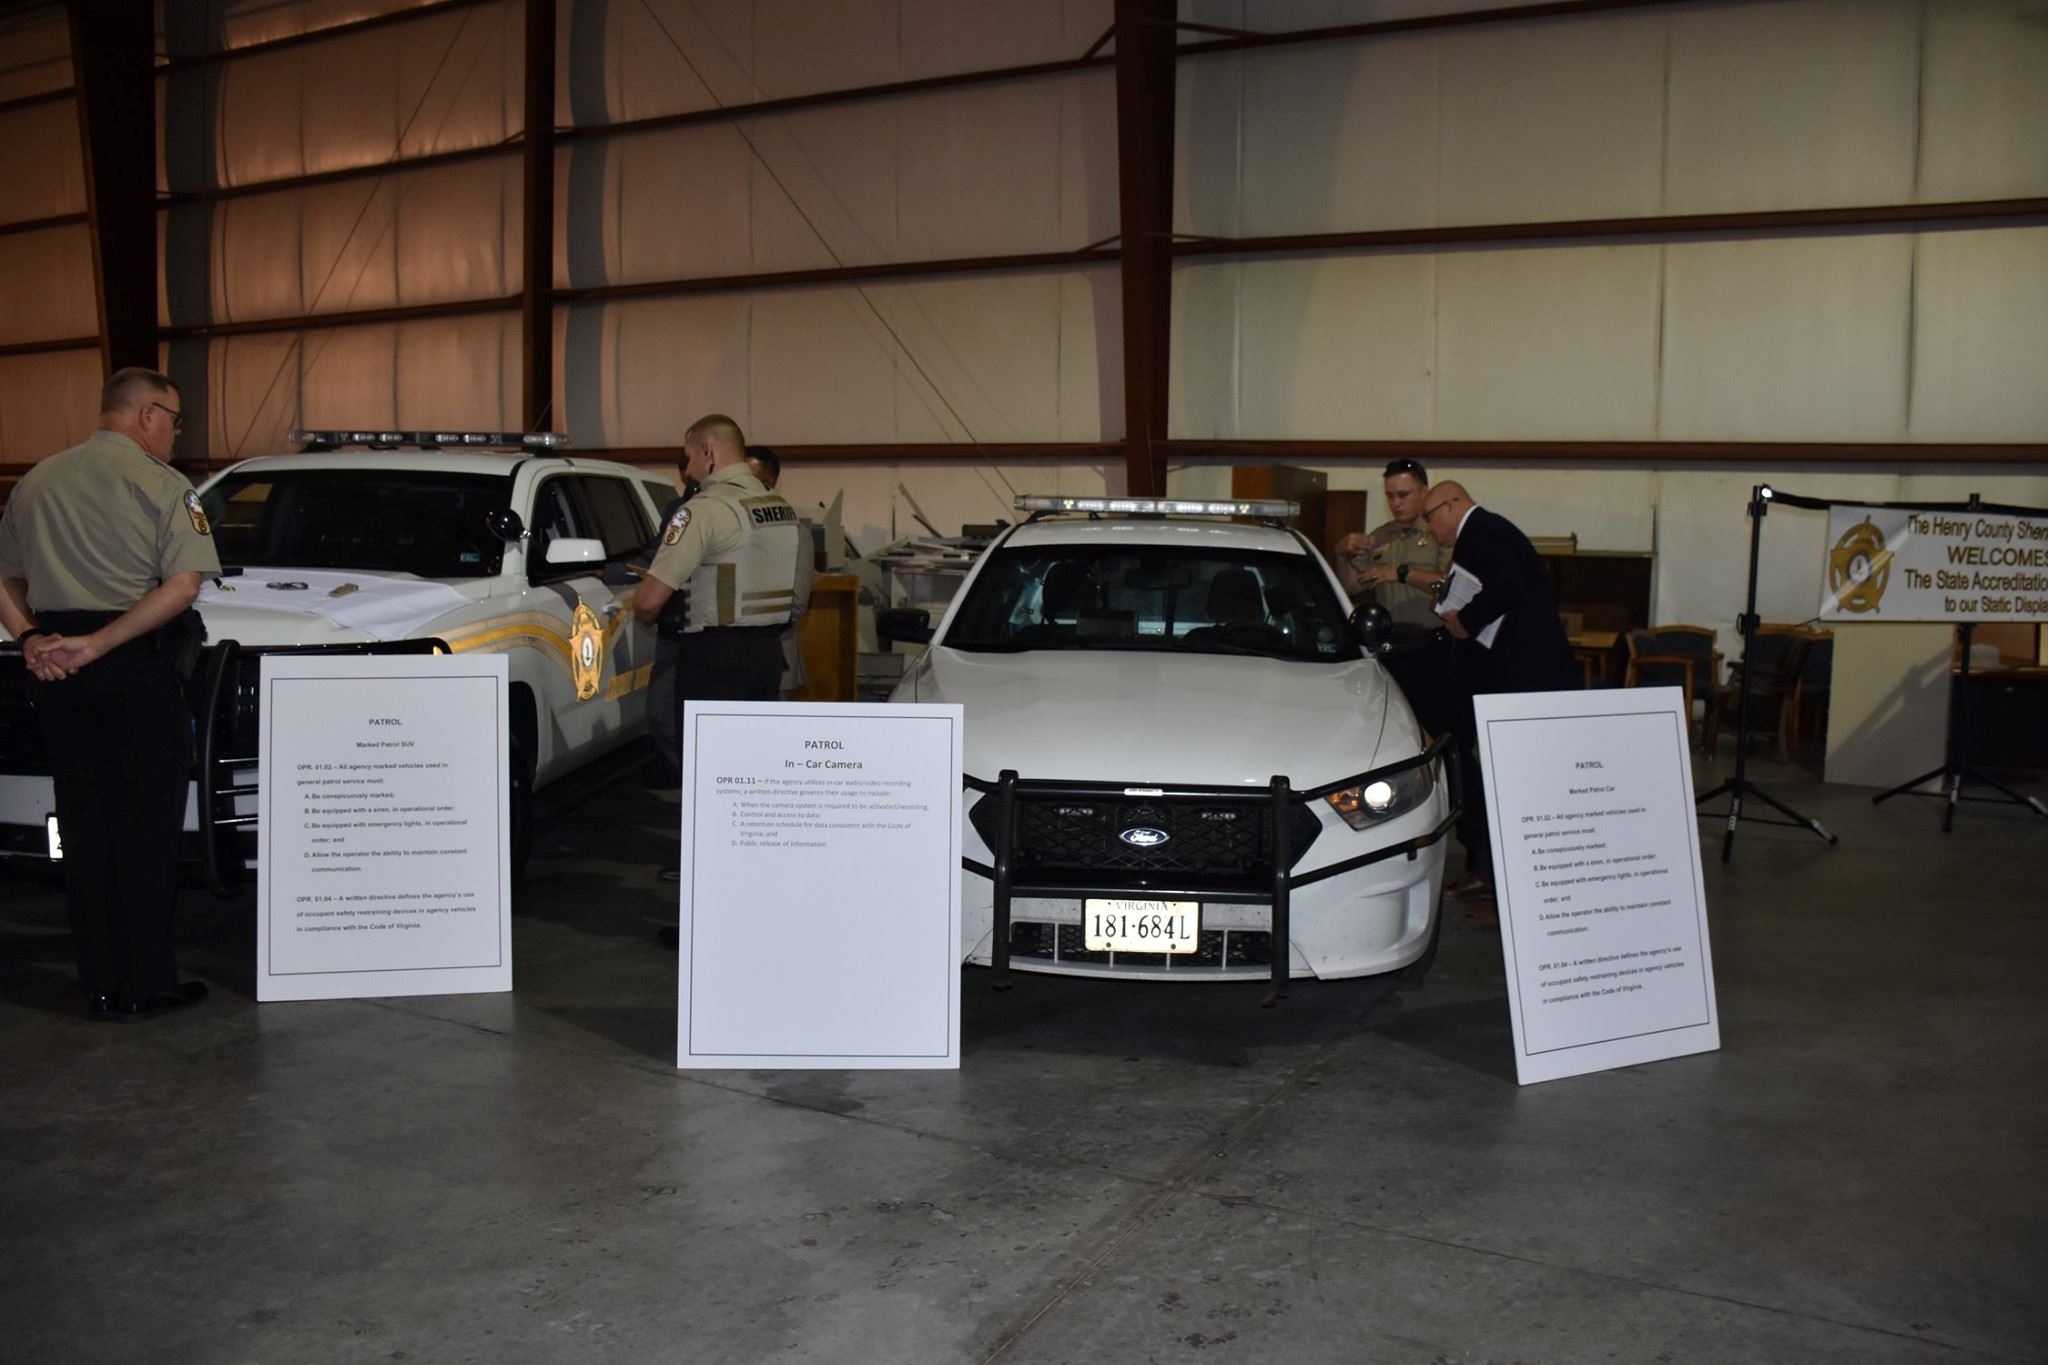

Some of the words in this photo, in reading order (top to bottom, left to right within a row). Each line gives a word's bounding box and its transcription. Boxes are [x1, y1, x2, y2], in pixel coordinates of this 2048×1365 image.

[1908, 514, 1930, 535] The
[1932, 516, 1972, 541] Henry
[1975, 518, 2015, 543] County
[1904, 569, 1932, 589] The
[1936, 570, 1969, 590] State
[1945, 596, 1957, 612] to
[1960, 598, 1978, 613] our
[1981, 596, 2013, 613] Static
[369, 718, 402, 726] PATROL
[805, 740, 844, 750] PATROL
[785, 760, 795, 768] In
[806, 760, 822, 769] Car
[825, 760, 862, 769] Camera
[1575, 761, 1604, 770] PATROL
[1116, 901, 1168, 911] VIRGINIA
